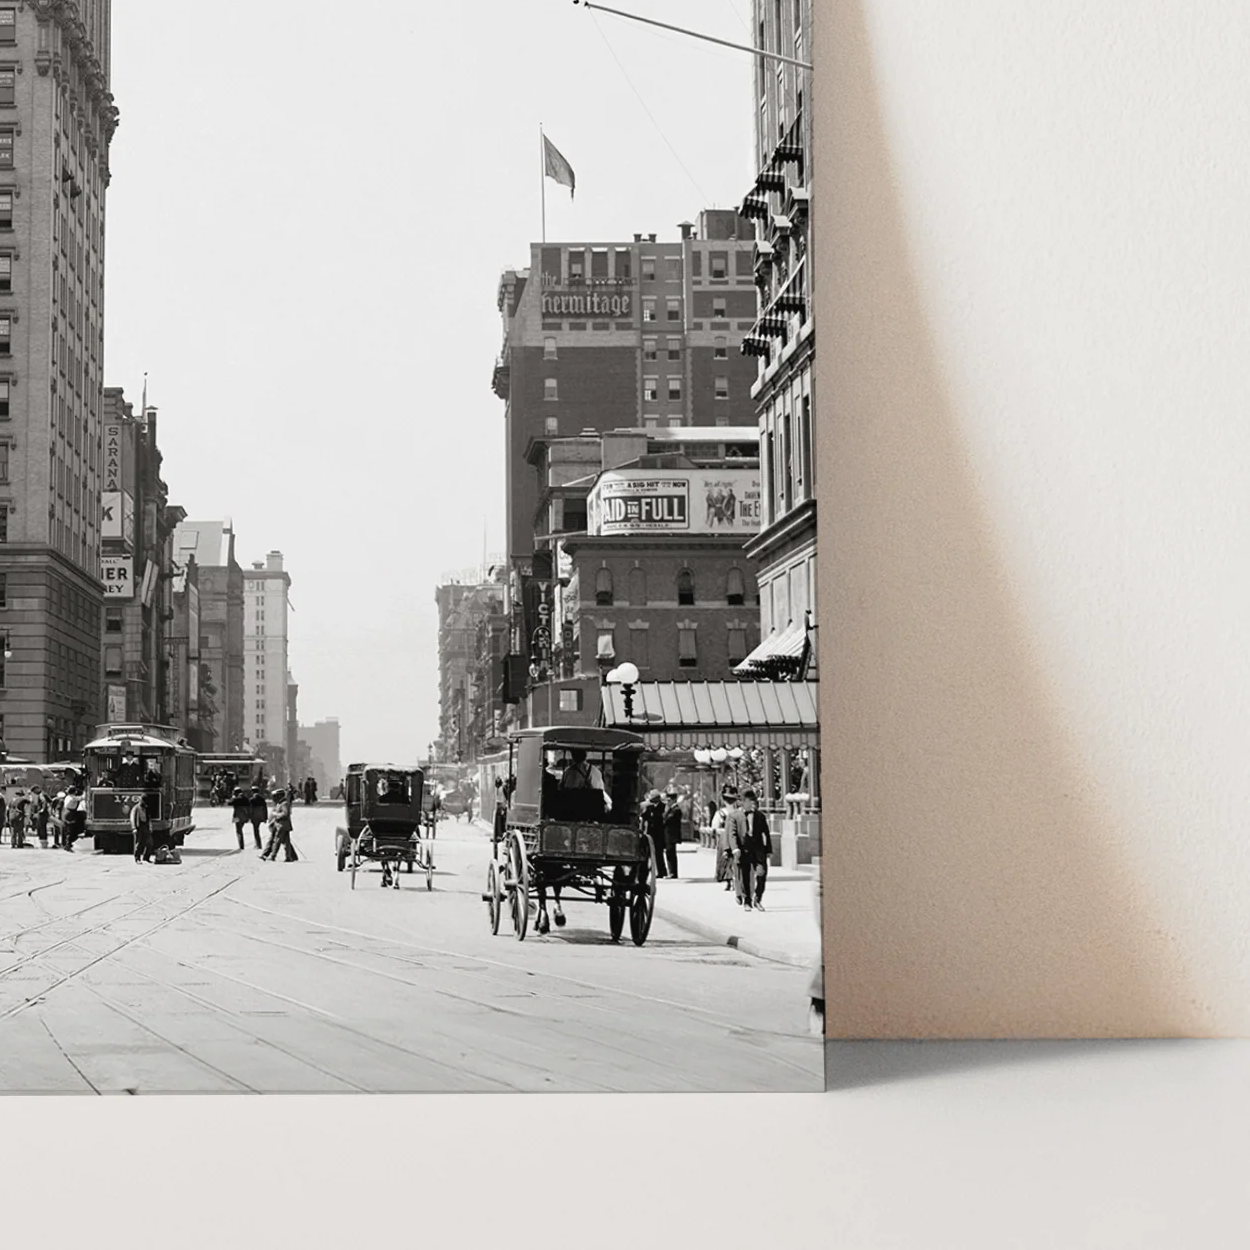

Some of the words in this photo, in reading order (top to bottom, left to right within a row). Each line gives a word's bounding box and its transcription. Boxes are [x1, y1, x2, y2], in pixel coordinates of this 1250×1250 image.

[603, 497, 626, 522] AID
[627, 505, 639, 515] IN
[641, 497, 684, 521] FULL
[537, 581, 550, 670] VICTORIA
